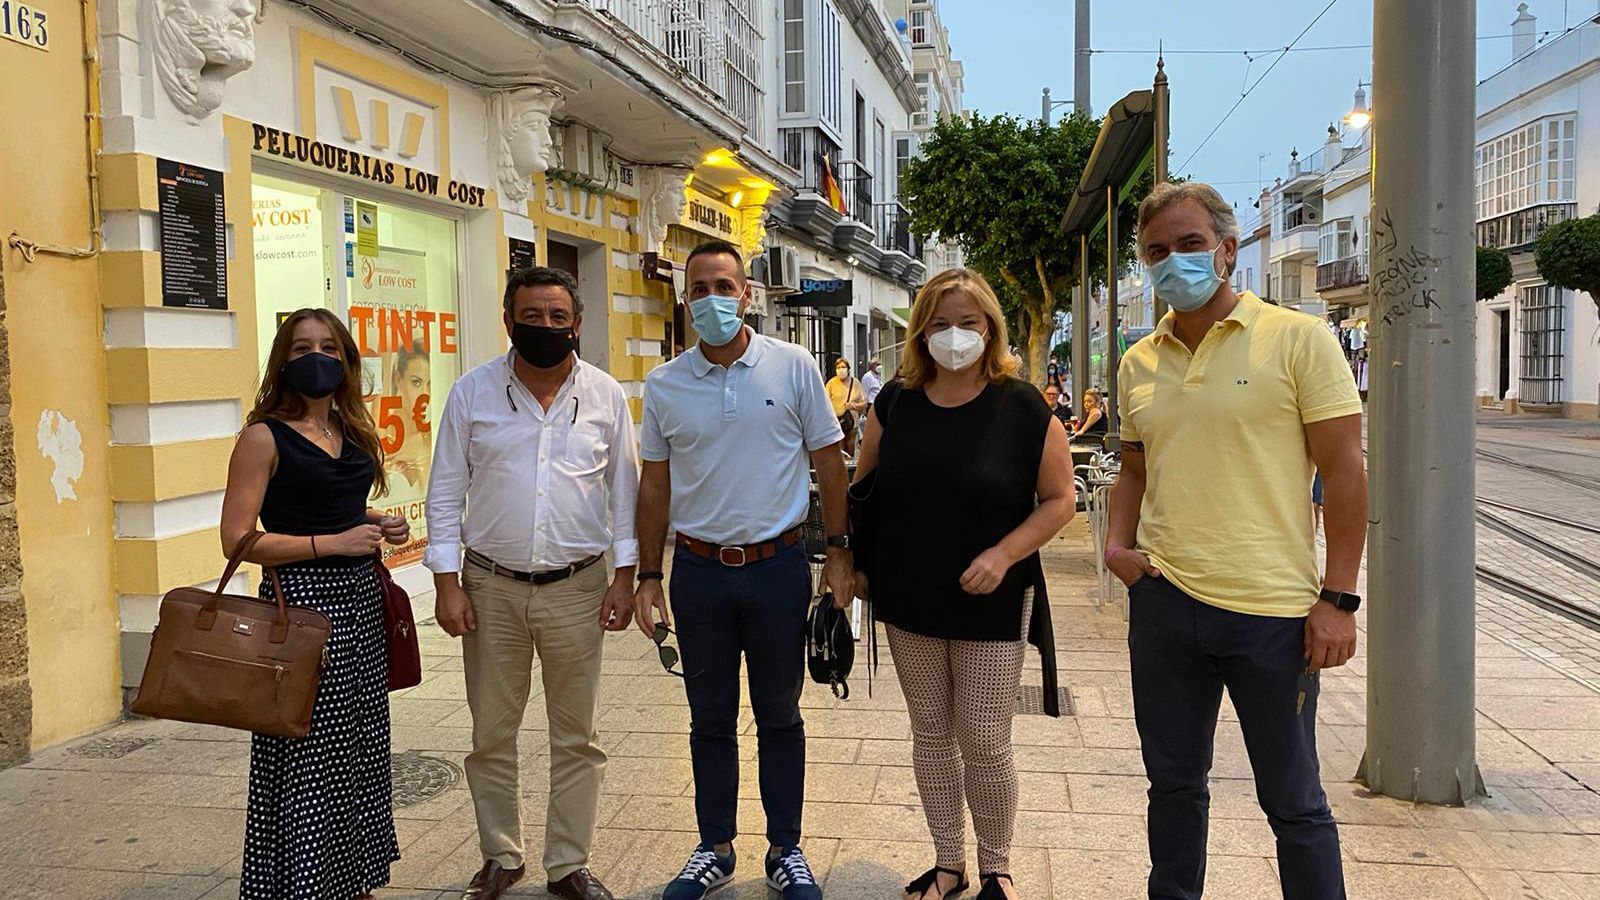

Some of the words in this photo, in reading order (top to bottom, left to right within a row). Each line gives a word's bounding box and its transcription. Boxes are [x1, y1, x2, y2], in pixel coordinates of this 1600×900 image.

[2, 1, 47, 46] 163
[252, 123, 394, 184] PELUQUERIAS
[405, 167, 439, 195] LOW
[448, 180, 485, 207] COST
[269, 209, 311, 227] COST
[378, 275, 397, 286] LOW
[398, 277, 416, 289] COST
[803, 278, 844, 293] yoigo
[350, 306, 457, 353] TINTE
